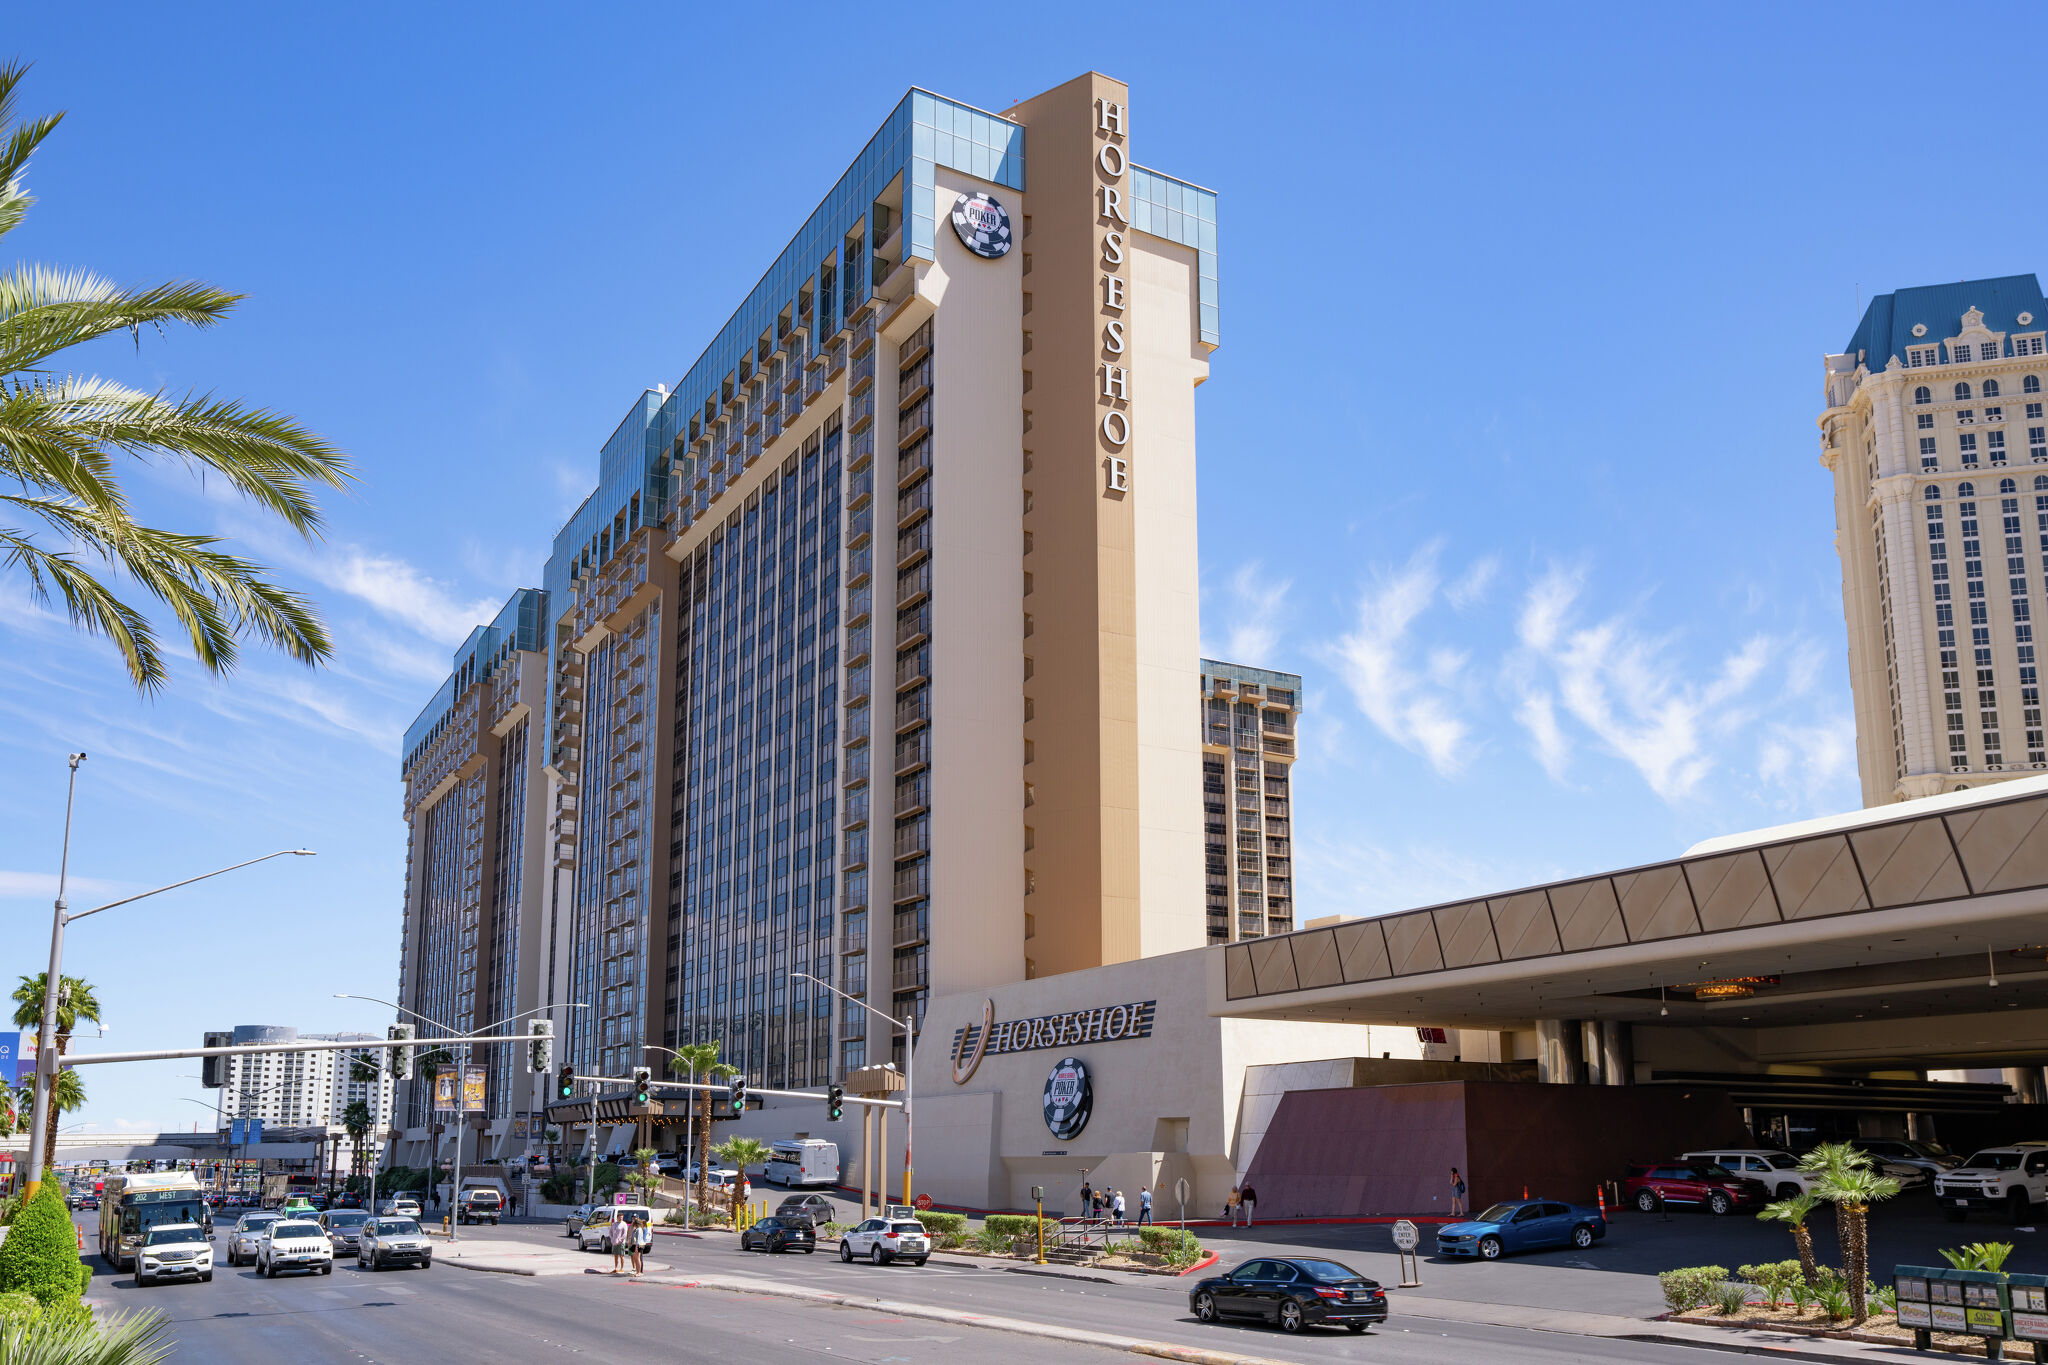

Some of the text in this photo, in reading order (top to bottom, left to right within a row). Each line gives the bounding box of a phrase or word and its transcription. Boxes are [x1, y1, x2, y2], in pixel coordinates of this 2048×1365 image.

[969, 207, 996, 226] POKER
[1098, 97, 1131, 494] HORSESHOE
[993, 1002, 1146, 1053] HORSESHOE
[1054, 1081, 1075, 1095] POKER
[135, 1191, 177, 1201] 202 WEST
